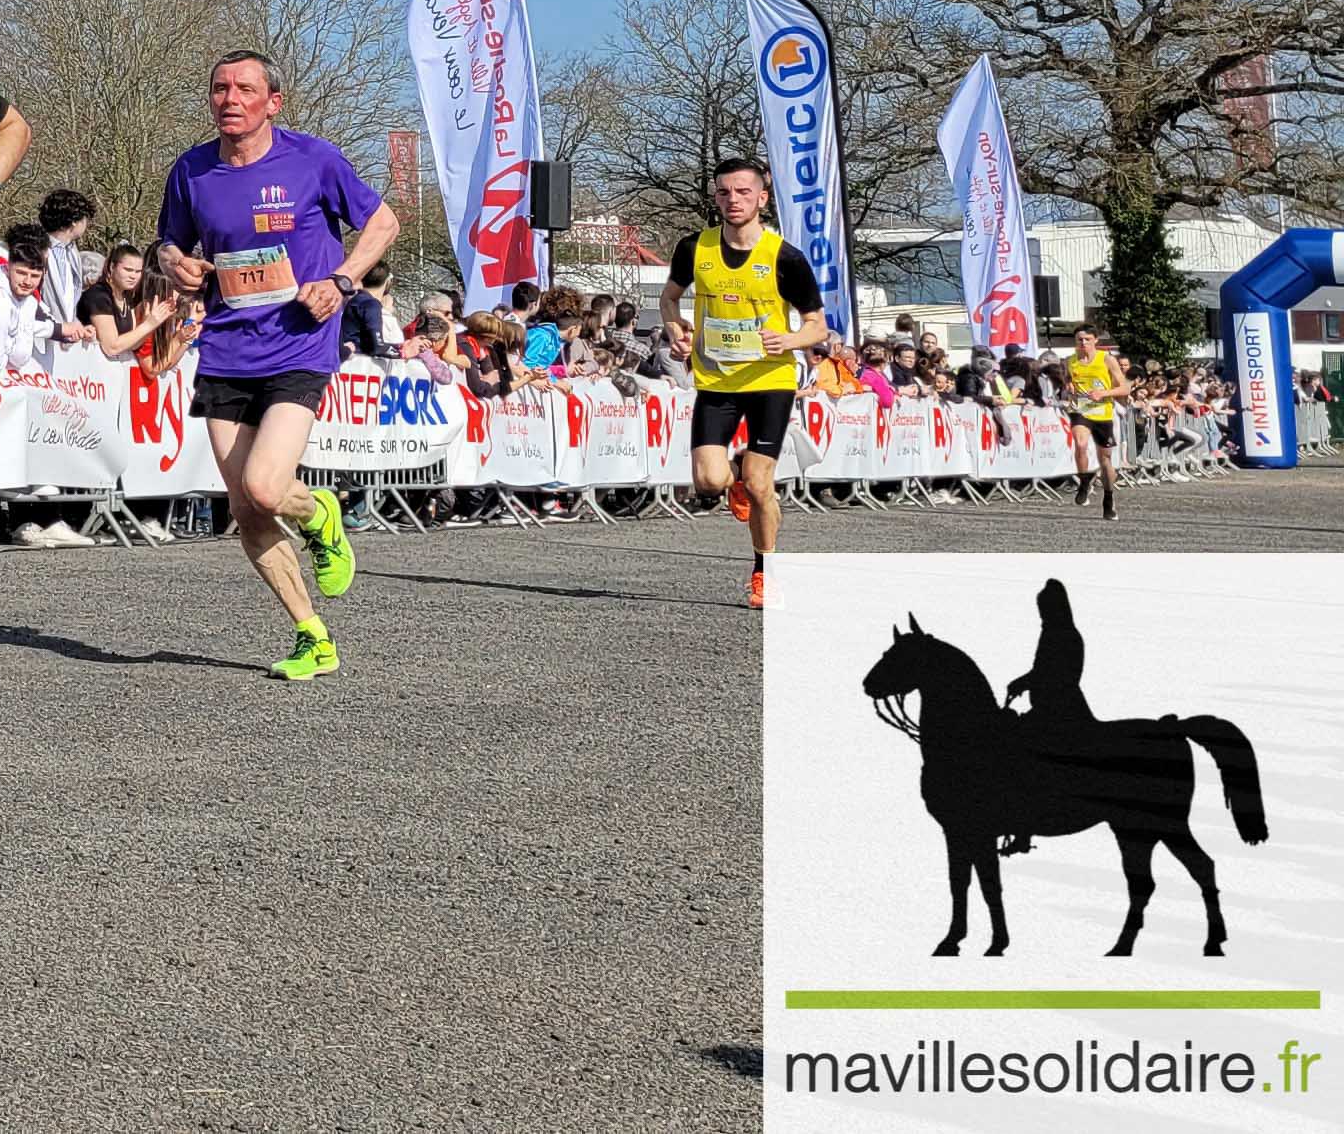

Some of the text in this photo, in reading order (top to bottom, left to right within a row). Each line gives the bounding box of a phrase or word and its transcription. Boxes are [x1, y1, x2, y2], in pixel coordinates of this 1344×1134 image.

[239, 269, 266, 285] 717
[721, 333, 741, 343] 950
[1244, 326, 1269, 429] INTERSPORT
[319, 437, 429, 454] LA ROCHE SUR YON
